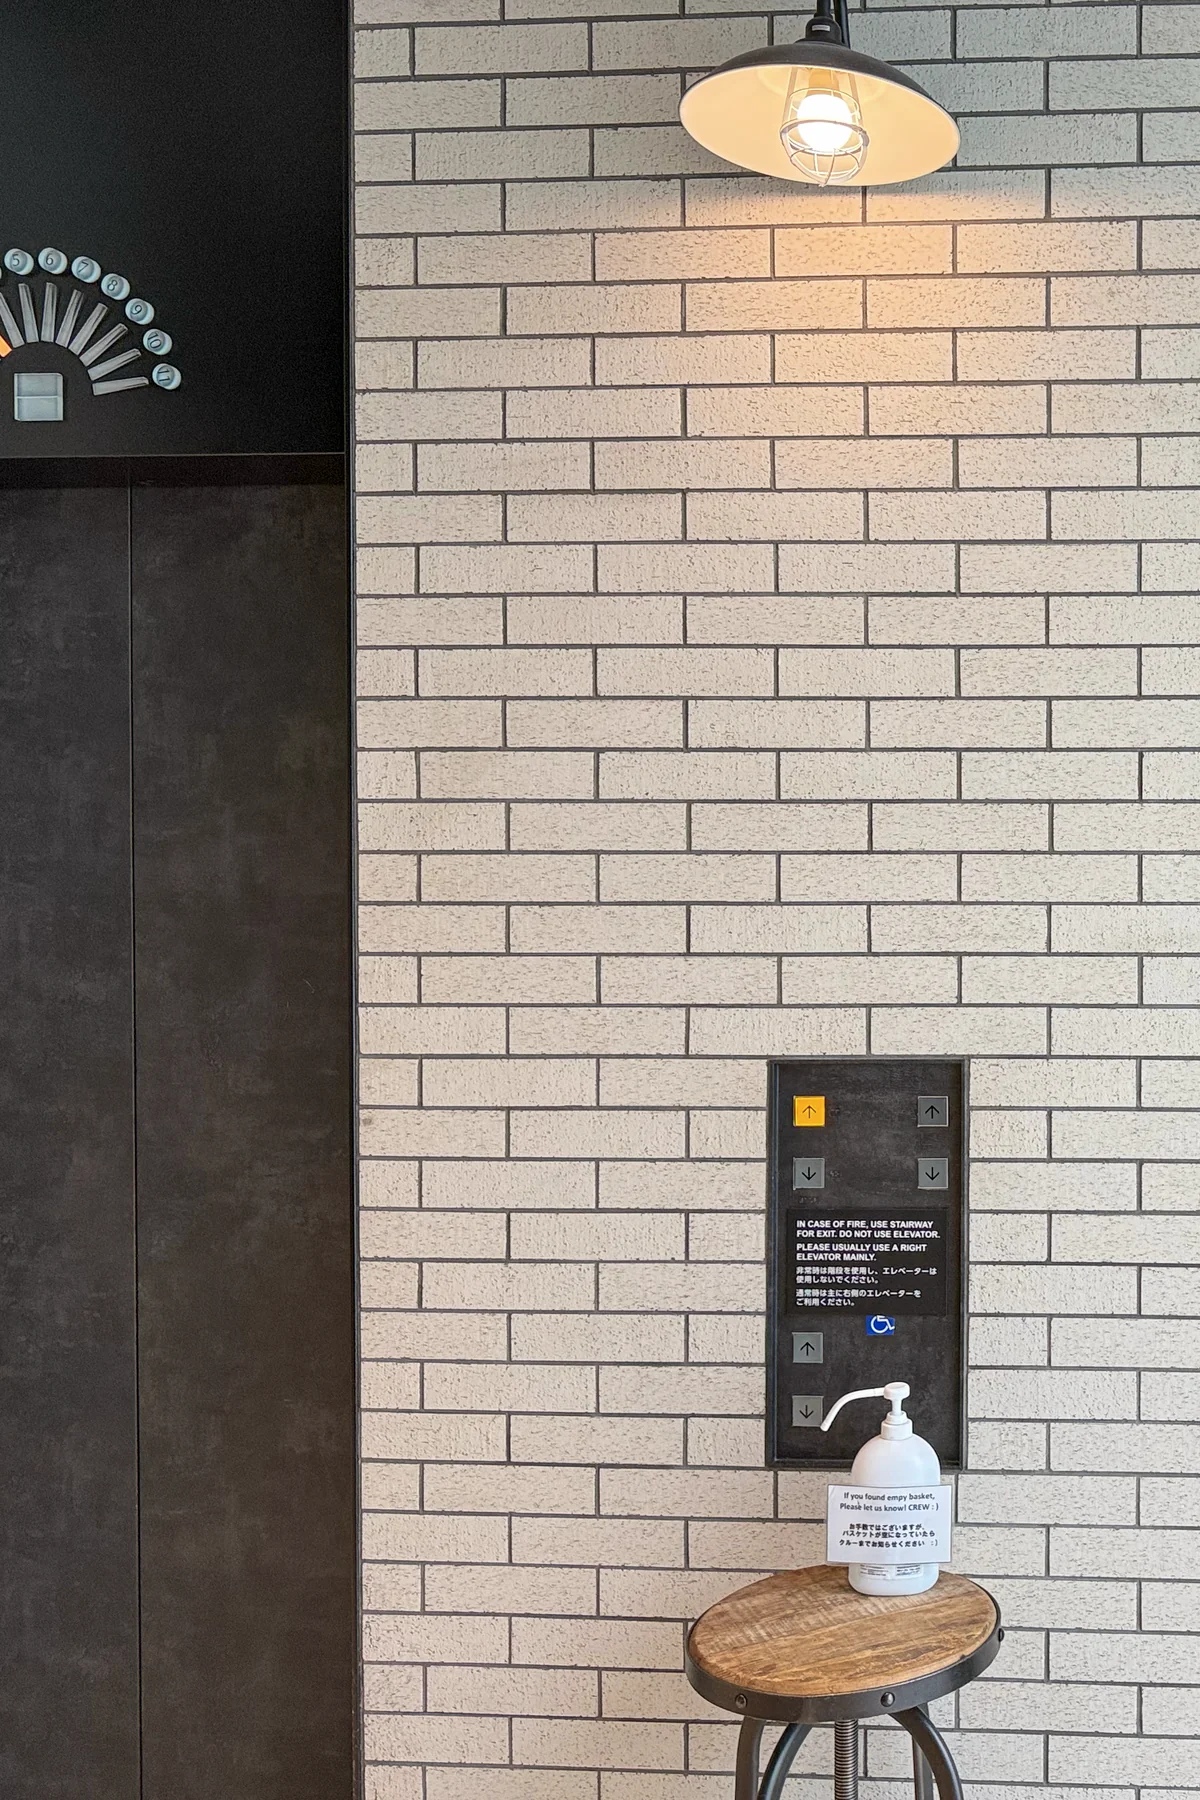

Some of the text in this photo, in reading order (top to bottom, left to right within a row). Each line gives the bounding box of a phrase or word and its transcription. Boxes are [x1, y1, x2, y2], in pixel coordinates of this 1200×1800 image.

[796, 1220, 934, 1228] IN CASE OF FIRE, USE STAIRWAY
[796, 1230, 940, 1238] FOR EXIT. DO NOT USE ELEVATOR.
[796, 1253, 877, 1261] ELEVATOR MAINLY.
[865, 1493, 885, 1501] found
[887, 1494, 907, 1502] empy
[909, 1493, 935, 1501] basket,
